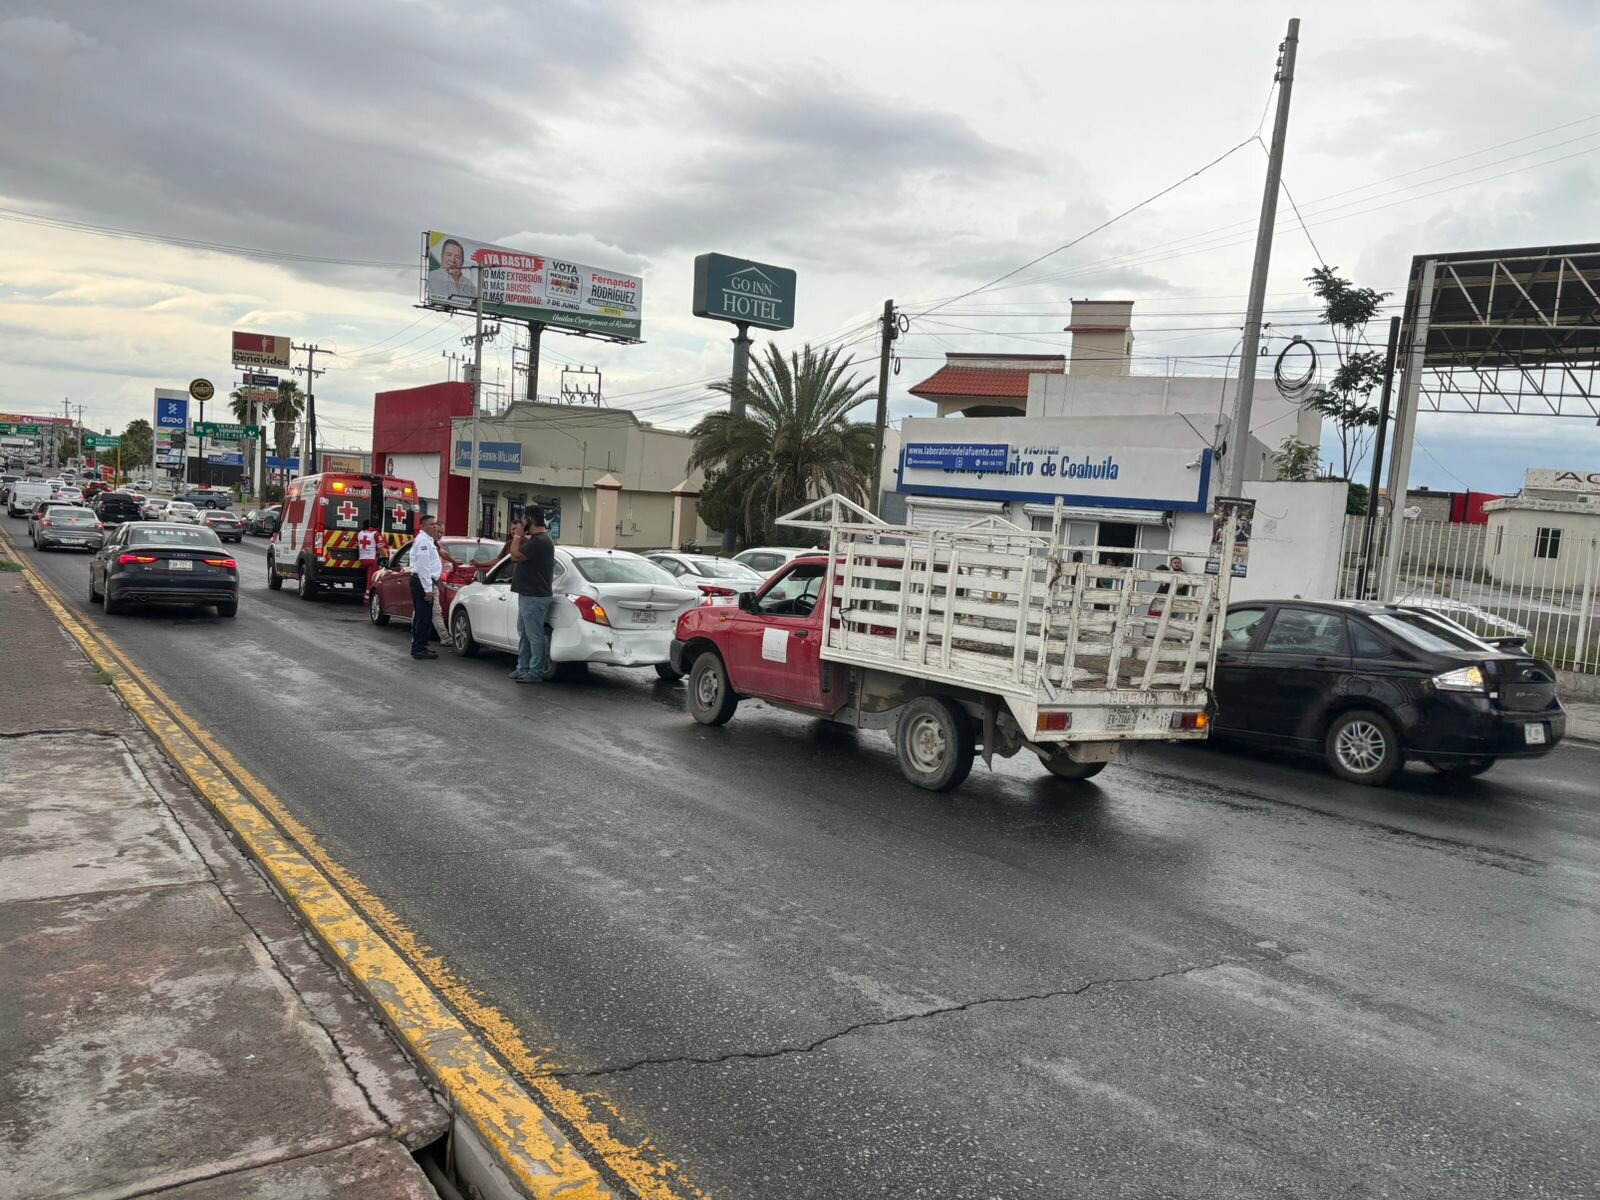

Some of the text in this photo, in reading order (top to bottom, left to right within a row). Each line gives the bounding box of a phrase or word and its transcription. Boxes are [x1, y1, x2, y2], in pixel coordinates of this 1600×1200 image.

[501, 256, 535, 269] BASTA!
[552, 261, 578, 275] VOTA
[490, 270, 505, 281] MÁS
[591, 273, 636, 289] Fernando
[489, 280, 505, 291] MÁS
[731, 276, 772, 296] GO INN
[489, 291, 504, 303] MÁS
[591, 285, 636, 305] RODRÍGUEZ
[562, 302, 580, 311] JUNIO
[723, 293, 780, 321] HOTEL
[233, 351, 288, 366] benavides
[908, 446, 1005, 457] www.laboratoriodelafuente.com
[1041, 456, 1056, 476] de
[1060, 456, 1119, 480] Coahuila
